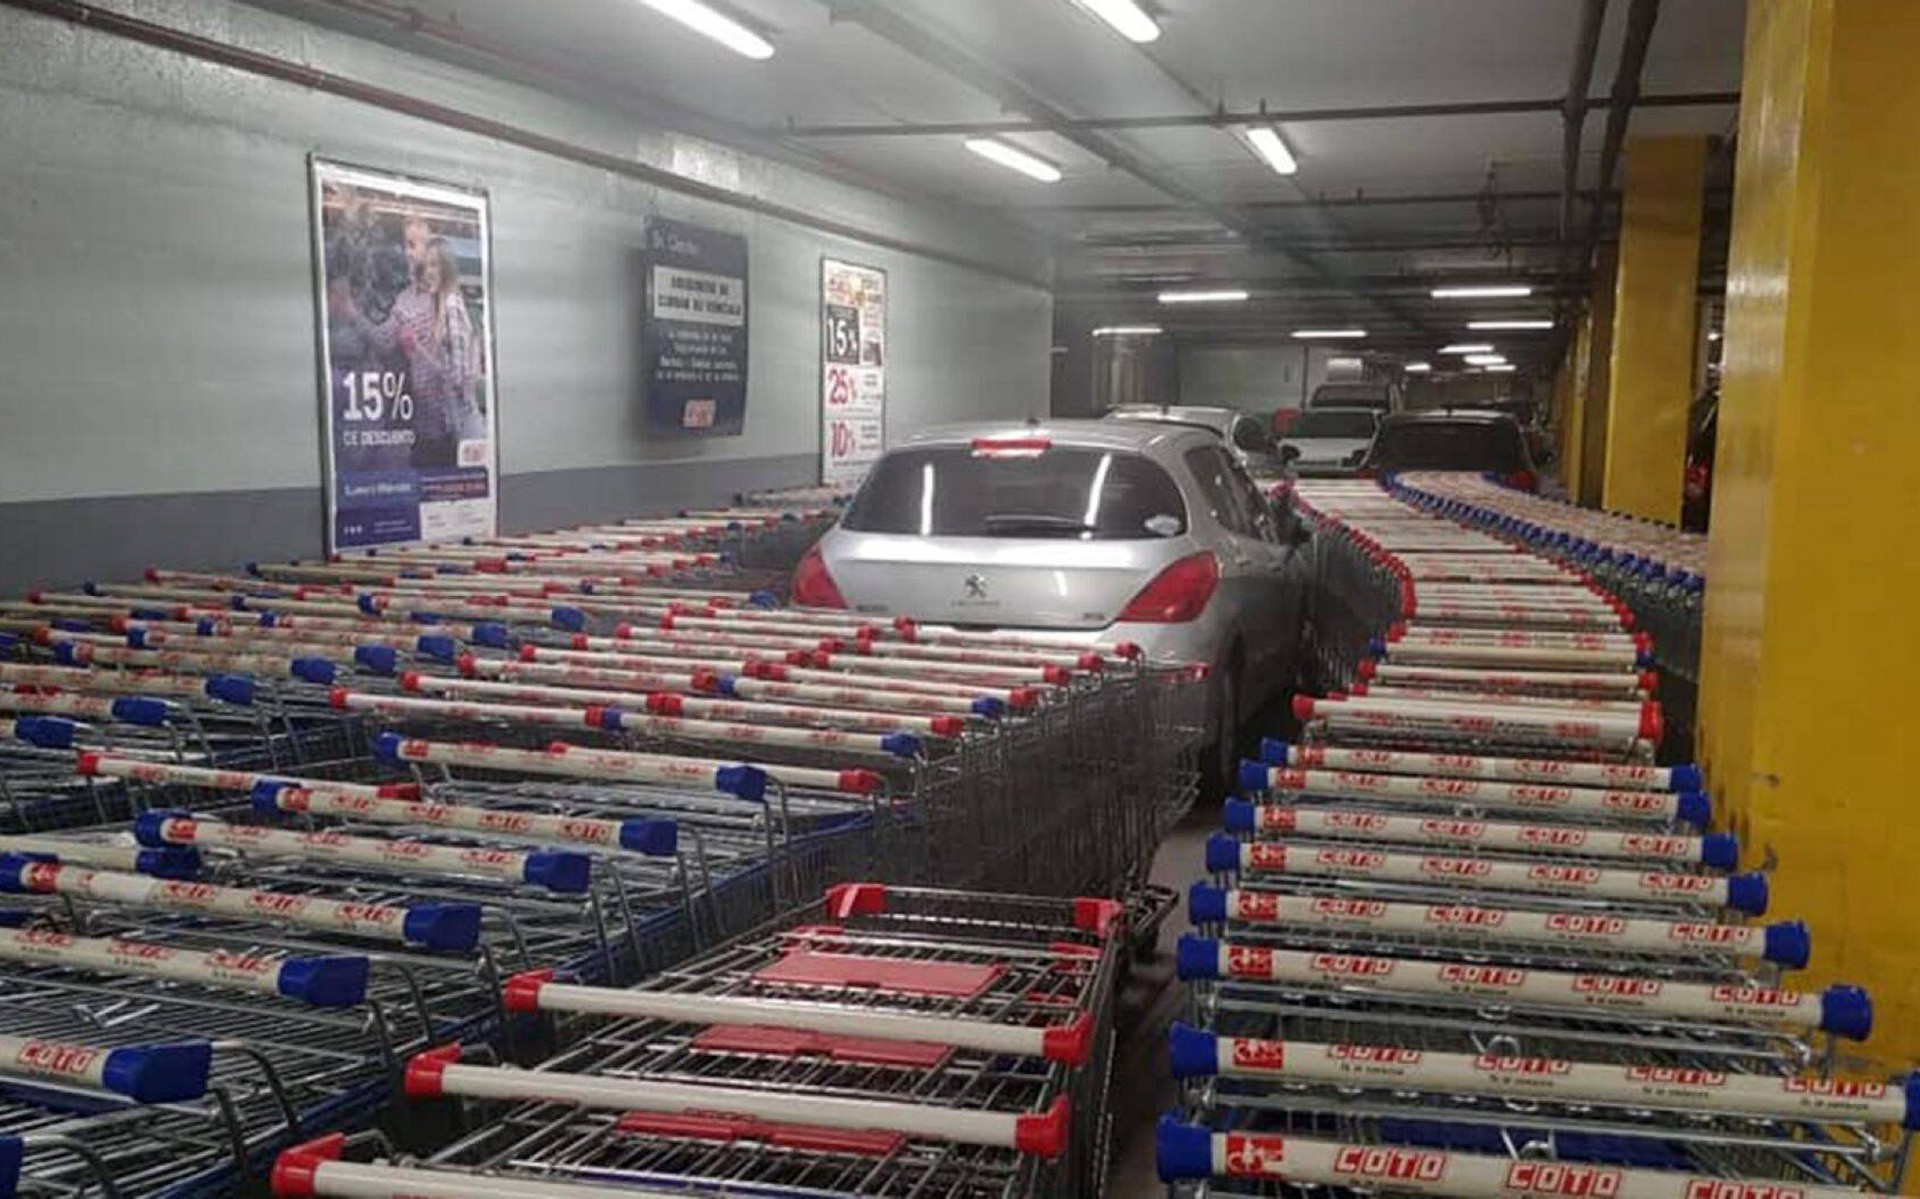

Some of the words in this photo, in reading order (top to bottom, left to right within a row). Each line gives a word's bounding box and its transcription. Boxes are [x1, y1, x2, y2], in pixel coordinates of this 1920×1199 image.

[342, 371, 413, 421] 15%
[1519, 826, 1585, 845] COTO
[1621, 832, 1687, 851] COTO
[1316, 848, 1385, 866] COTO
[1421, 856, 1491, 875] COTO
[1529, 864, 1601, 883] COTO
[1640, 871, 1714, 890] COTO
[1311, 897, 1385, 917] COTO
[1427, 905, 1504, 925] COTO
[1546, 914, 1625, 935] COTO
[1671, 922, 1750, 941] COTO
[1312, 953, 1394, 976] COTO
[1439, 964, 1525, 987] COTO
[1573, 974, 1661, 996] COTO
[1712, 985, 1800, 1006] COTO
[17, 1038, 98, 1073] COTO
[1326, 1043, 1422, 1064] COTO
[1475, 1055, 1570, 1076] COTO
[1626, 1066, 1727, 1086] COTO
[1781, 1076, 1886, 1099] COTO
[1334, 1146, 1445, 1180] COTO
[1507, 1161, 1623, 1198] COTO
